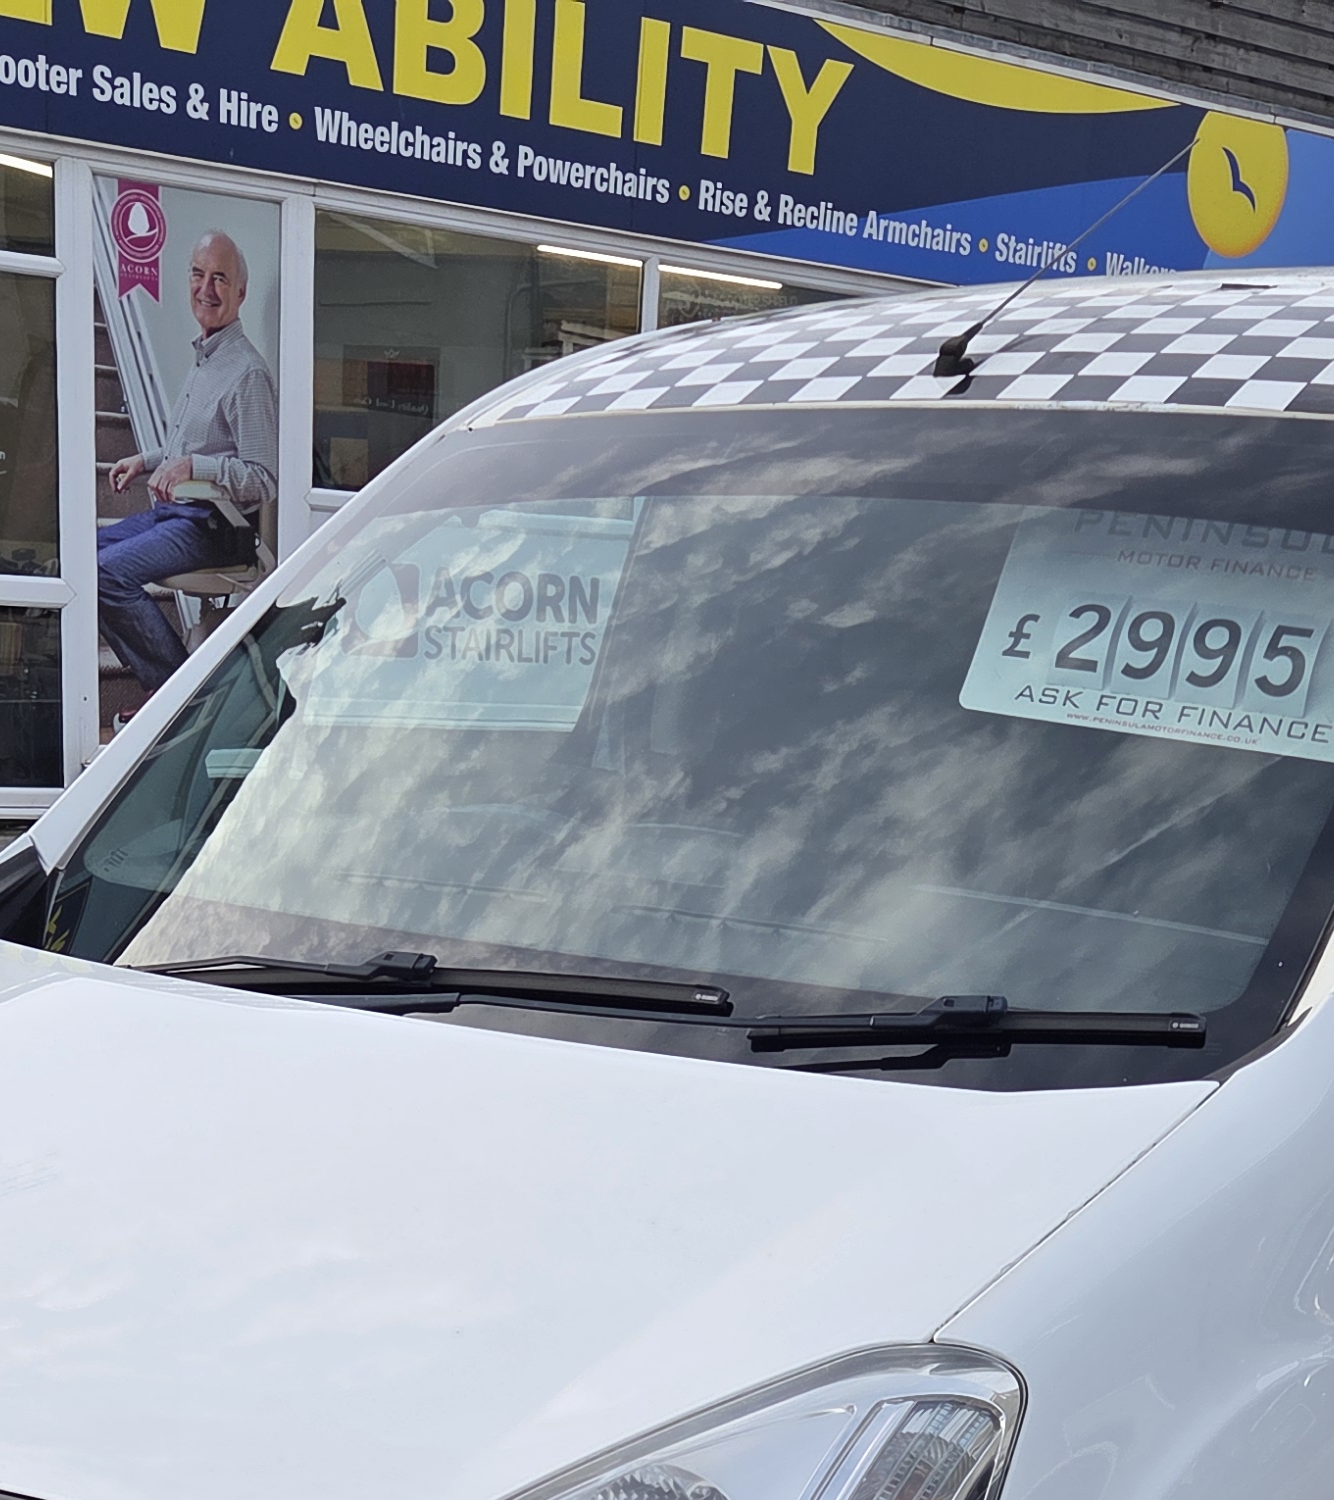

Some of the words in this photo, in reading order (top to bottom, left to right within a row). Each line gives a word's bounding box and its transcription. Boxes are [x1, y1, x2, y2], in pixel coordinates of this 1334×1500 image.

[269, 0, 855, 176] ABILITY
[92, 64, 177, 115] Sales
[185, 82, 210, 121] &
[219, 87, 280, 133] Hire
[313, 106, 482, 170] Wheelchairs
[488, 140, 510, 176] &
[516, 144, 670, 204] Powerchairs
[698, 178, 749, 218] Rise
[753, 189, 772, 223] &
[777, 193, 859, 236] Recline
[862, 210, 972, 257] Armchairs
[994, 231, 1078, 274] Stairlifts
[1105, 251, 1177, 276] Walk
[120, 263, 158, 276] ACORN
[1117, 549, 1202, 571] MOTOR
[1210, 557, 1319, 582] FINANCE
[424, 566, 600, 625] ACORN
[423, 624, 597, 666] STAIRLIFTS
[1013, 684, 1084, 709] ASK
[1095, 693, 1164, 720] FOR
[1177, 704, 1334, 744] FINANCE
